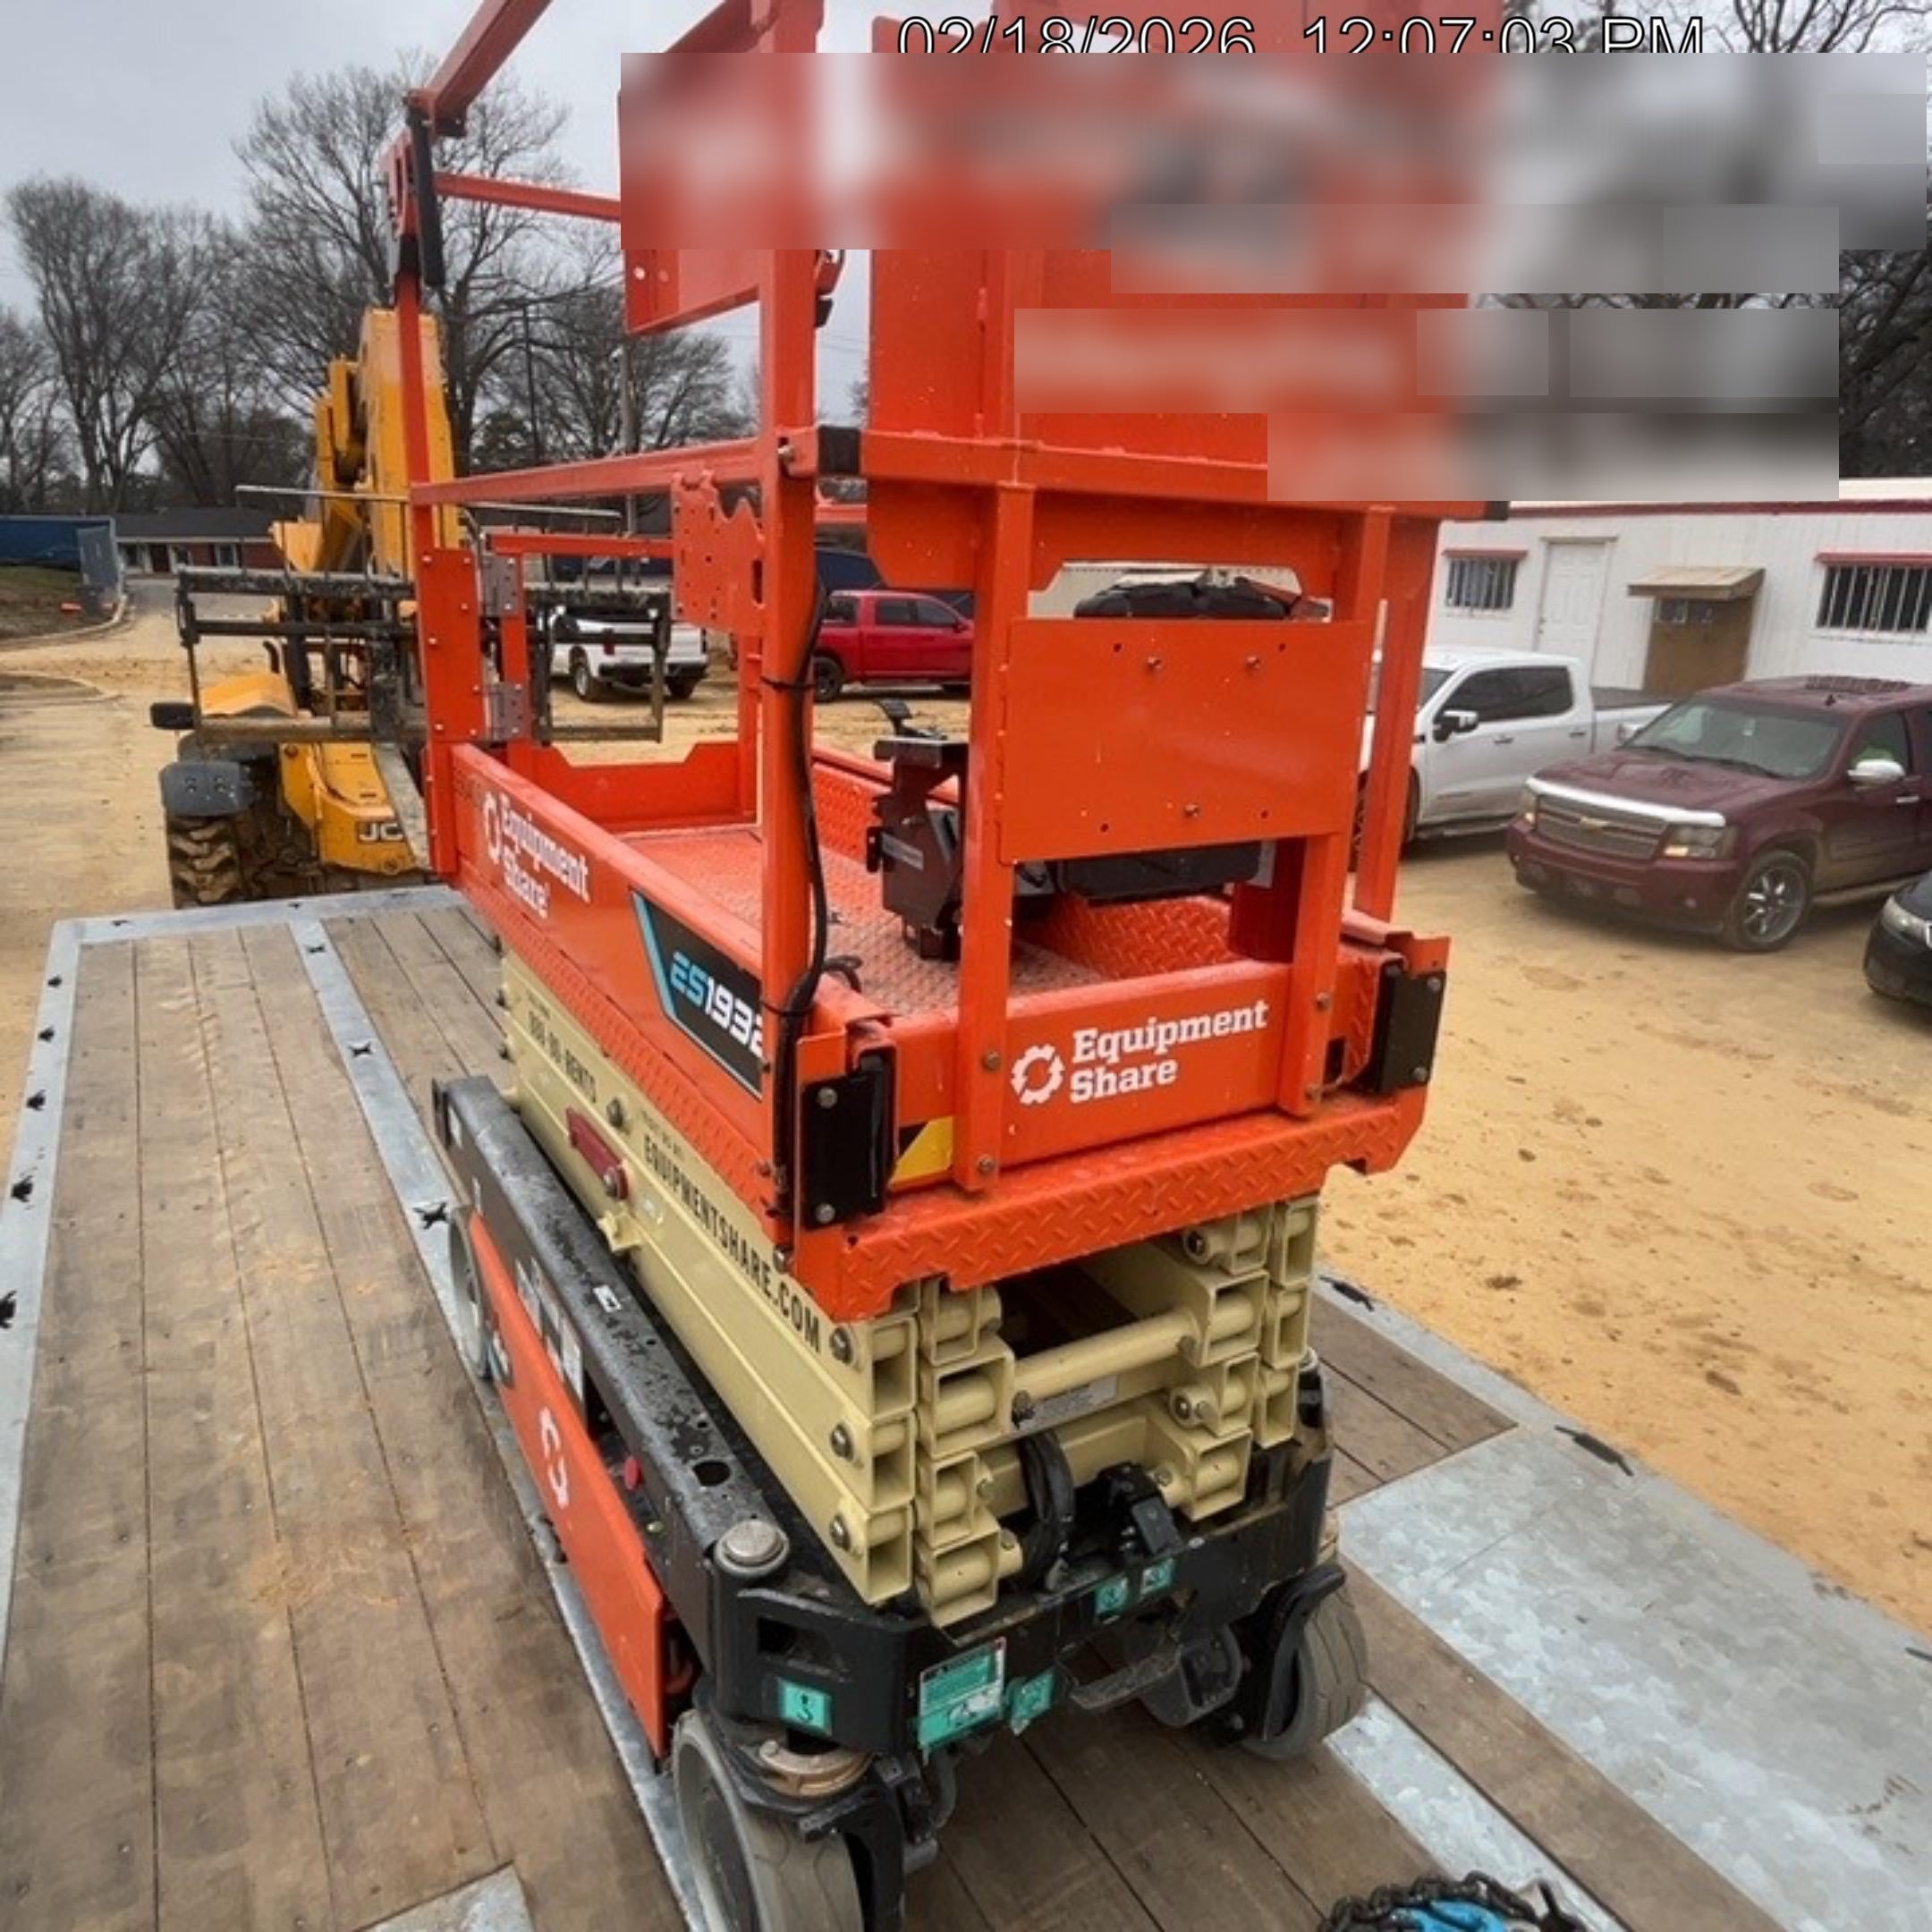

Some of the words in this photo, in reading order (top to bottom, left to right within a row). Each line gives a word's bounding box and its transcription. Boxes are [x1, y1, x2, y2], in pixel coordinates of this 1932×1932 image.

[359, 822, 404, 842] JC
[499, 792, 591, 903] Equipment
[504, 844, 549, 919] Share
[1072, 999, 1269, 1064] Equipment
[1070, 1059, 1178, 1104] Share
[644, 1132, 821, 1354] EQUIPMENTSHARE.COM
